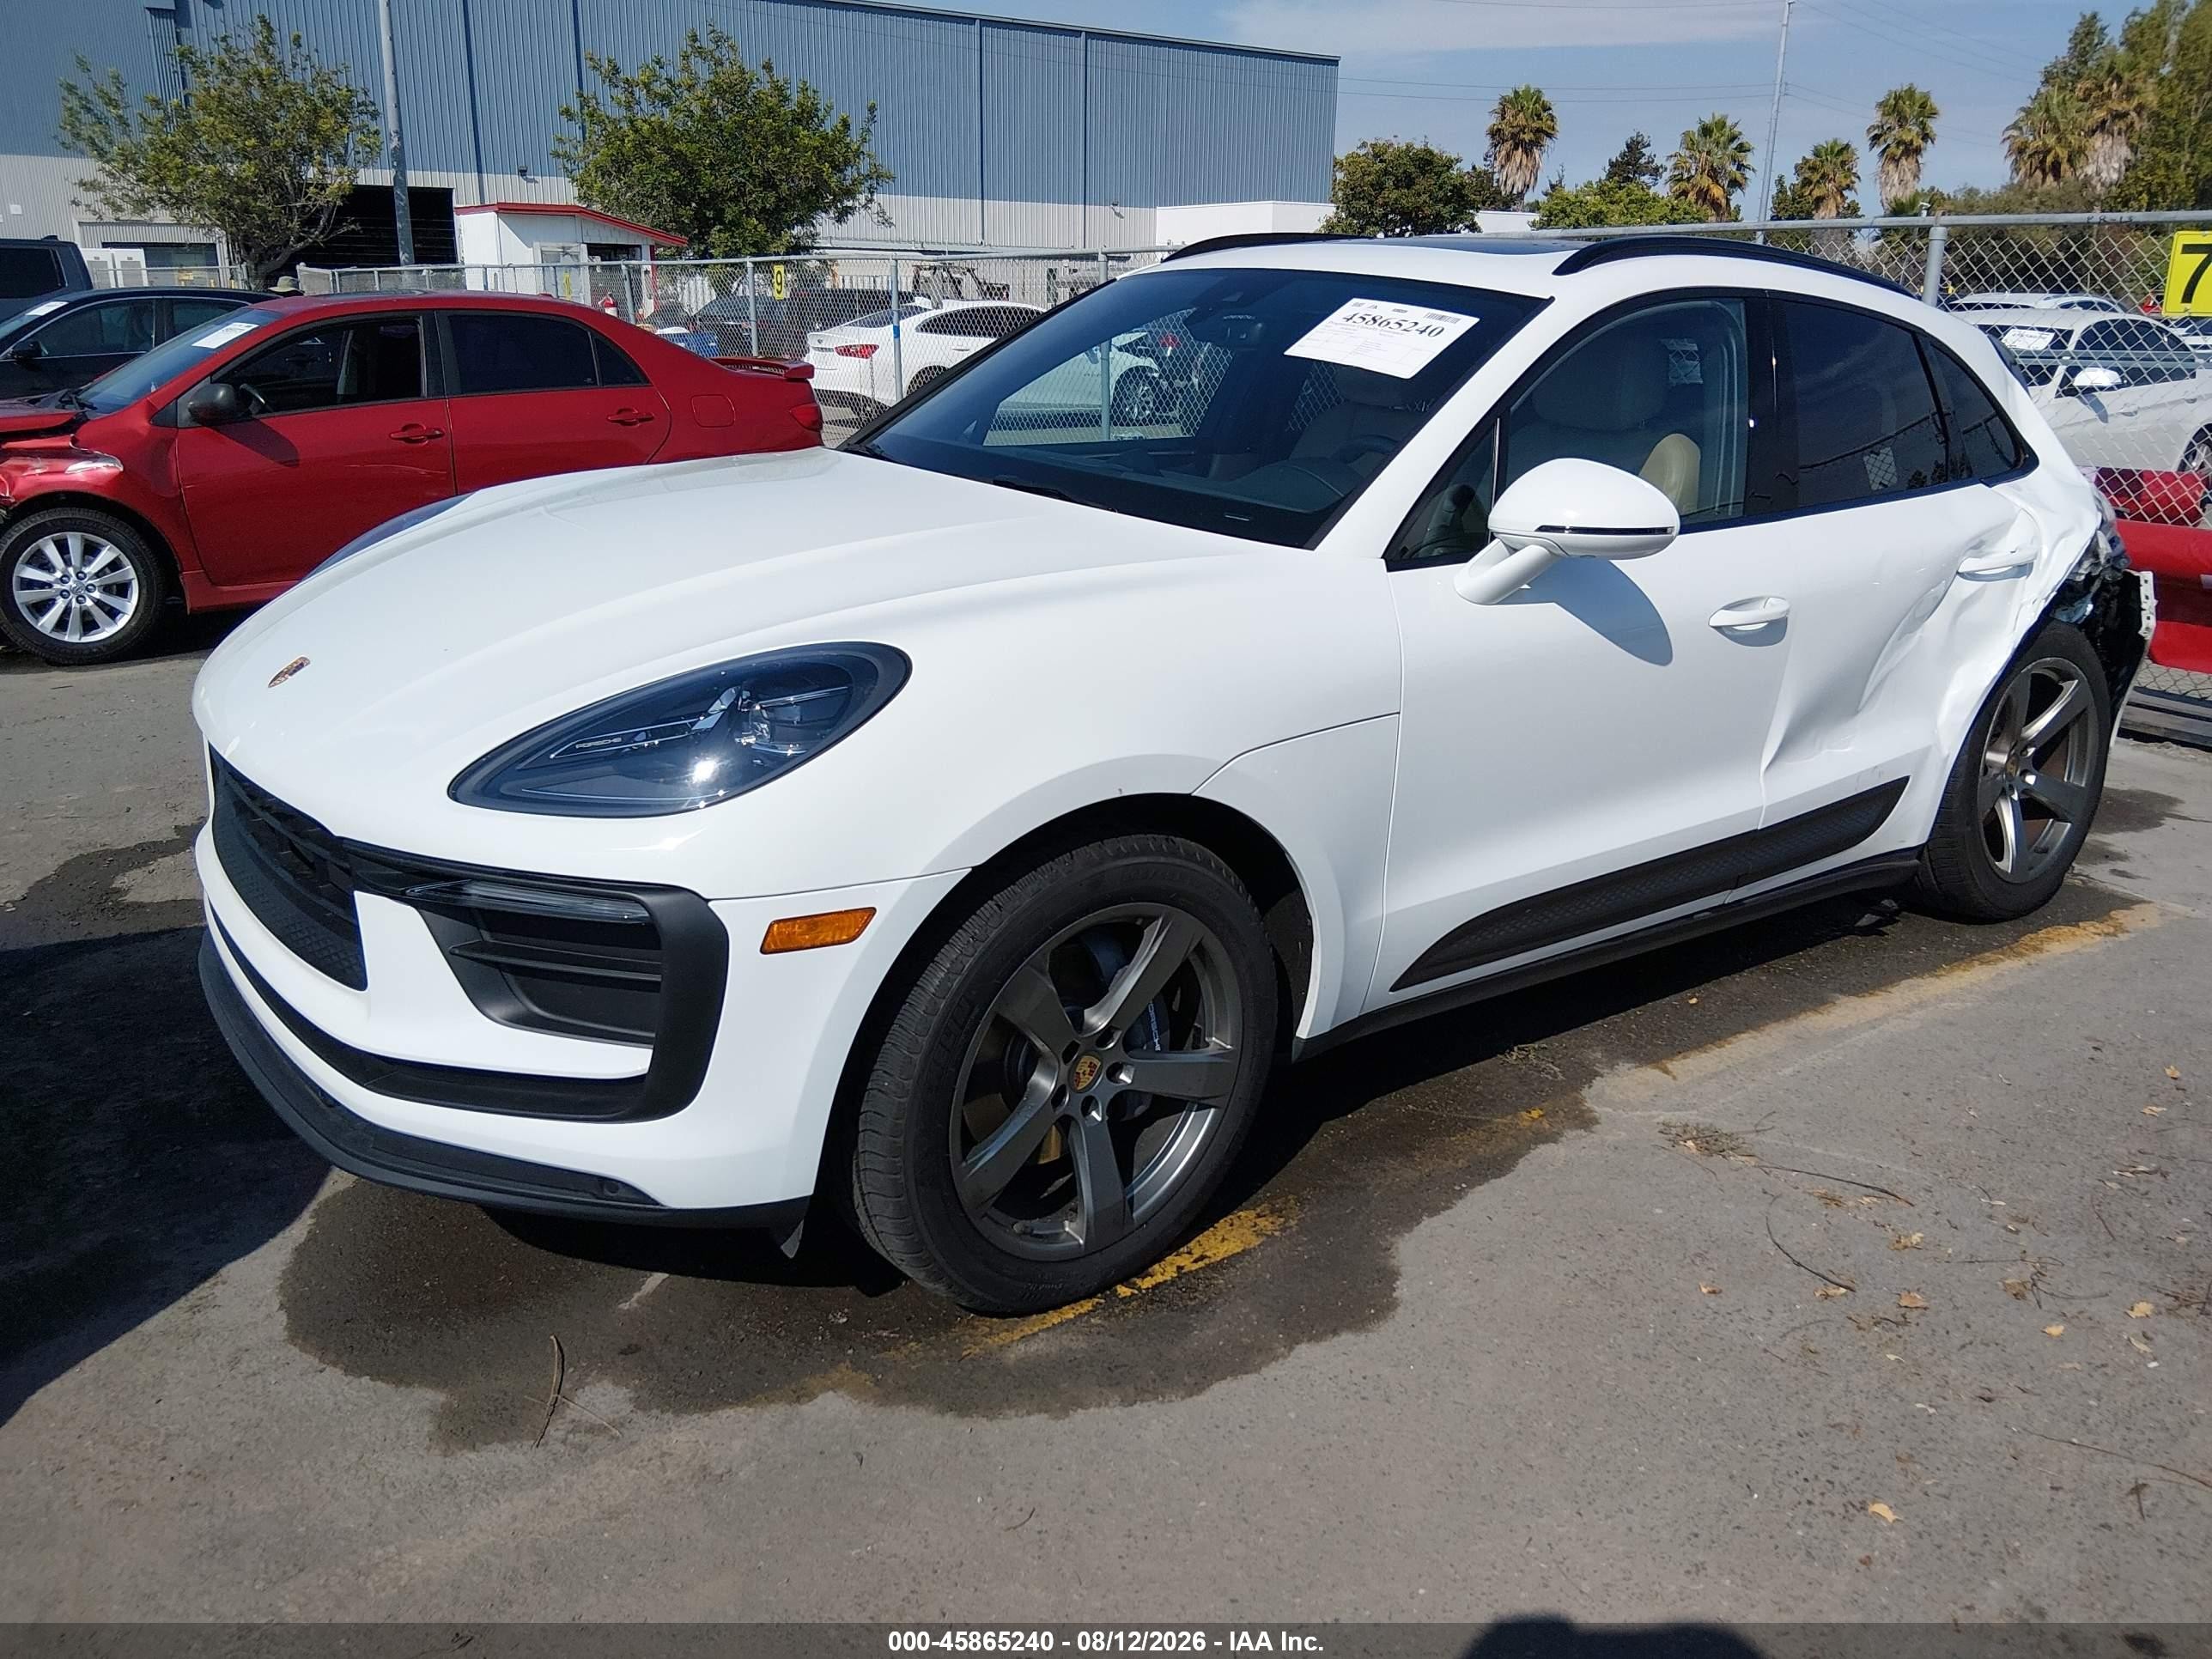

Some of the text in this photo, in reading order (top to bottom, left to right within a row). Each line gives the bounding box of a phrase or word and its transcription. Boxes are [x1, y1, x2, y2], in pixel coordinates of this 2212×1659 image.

[775, 270, 783, 295] 9
[2180, 243, 2212, 304] 7
[1342, 312, 1445, 337] 45865240
